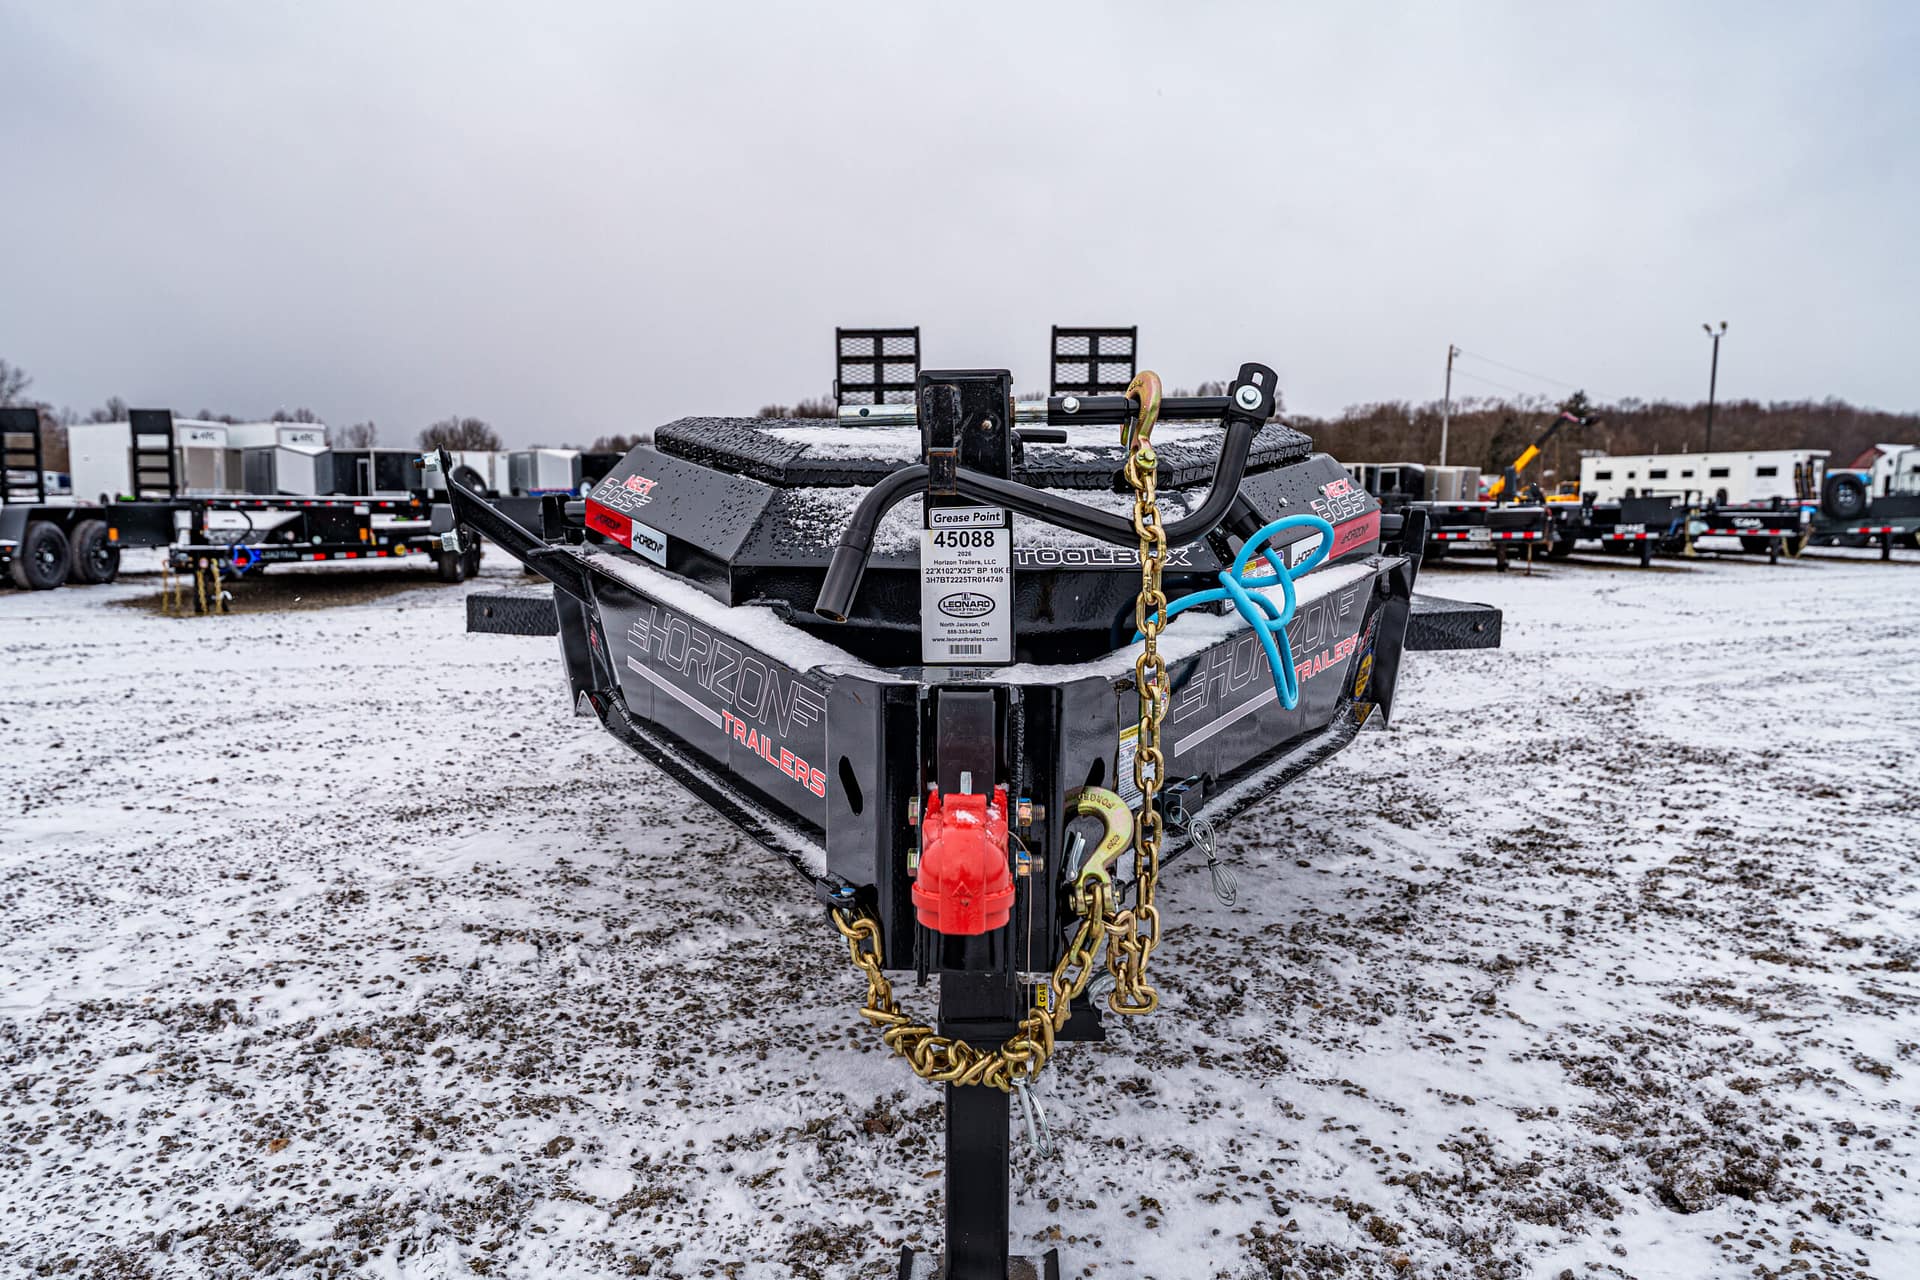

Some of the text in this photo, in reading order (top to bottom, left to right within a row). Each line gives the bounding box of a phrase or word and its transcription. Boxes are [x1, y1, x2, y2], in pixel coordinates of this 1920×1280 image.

[592, 477, 652, 512] BOSS
[622, 474, 658, 496] NECK
[1324, 478, 1353, 499] NECK
[1310, 488, 1366, 524] BOSS
[933, 511, 1001, 523] Grease Point
[933, 530, 995, 548] 45088
[1013, 548, 1192, 566] TOOLBX
[943, 600, 990, 608] LEONARD
[628, 606, 825, 737] HORIZON
[721, 708, 826, 798] TRAILERS
